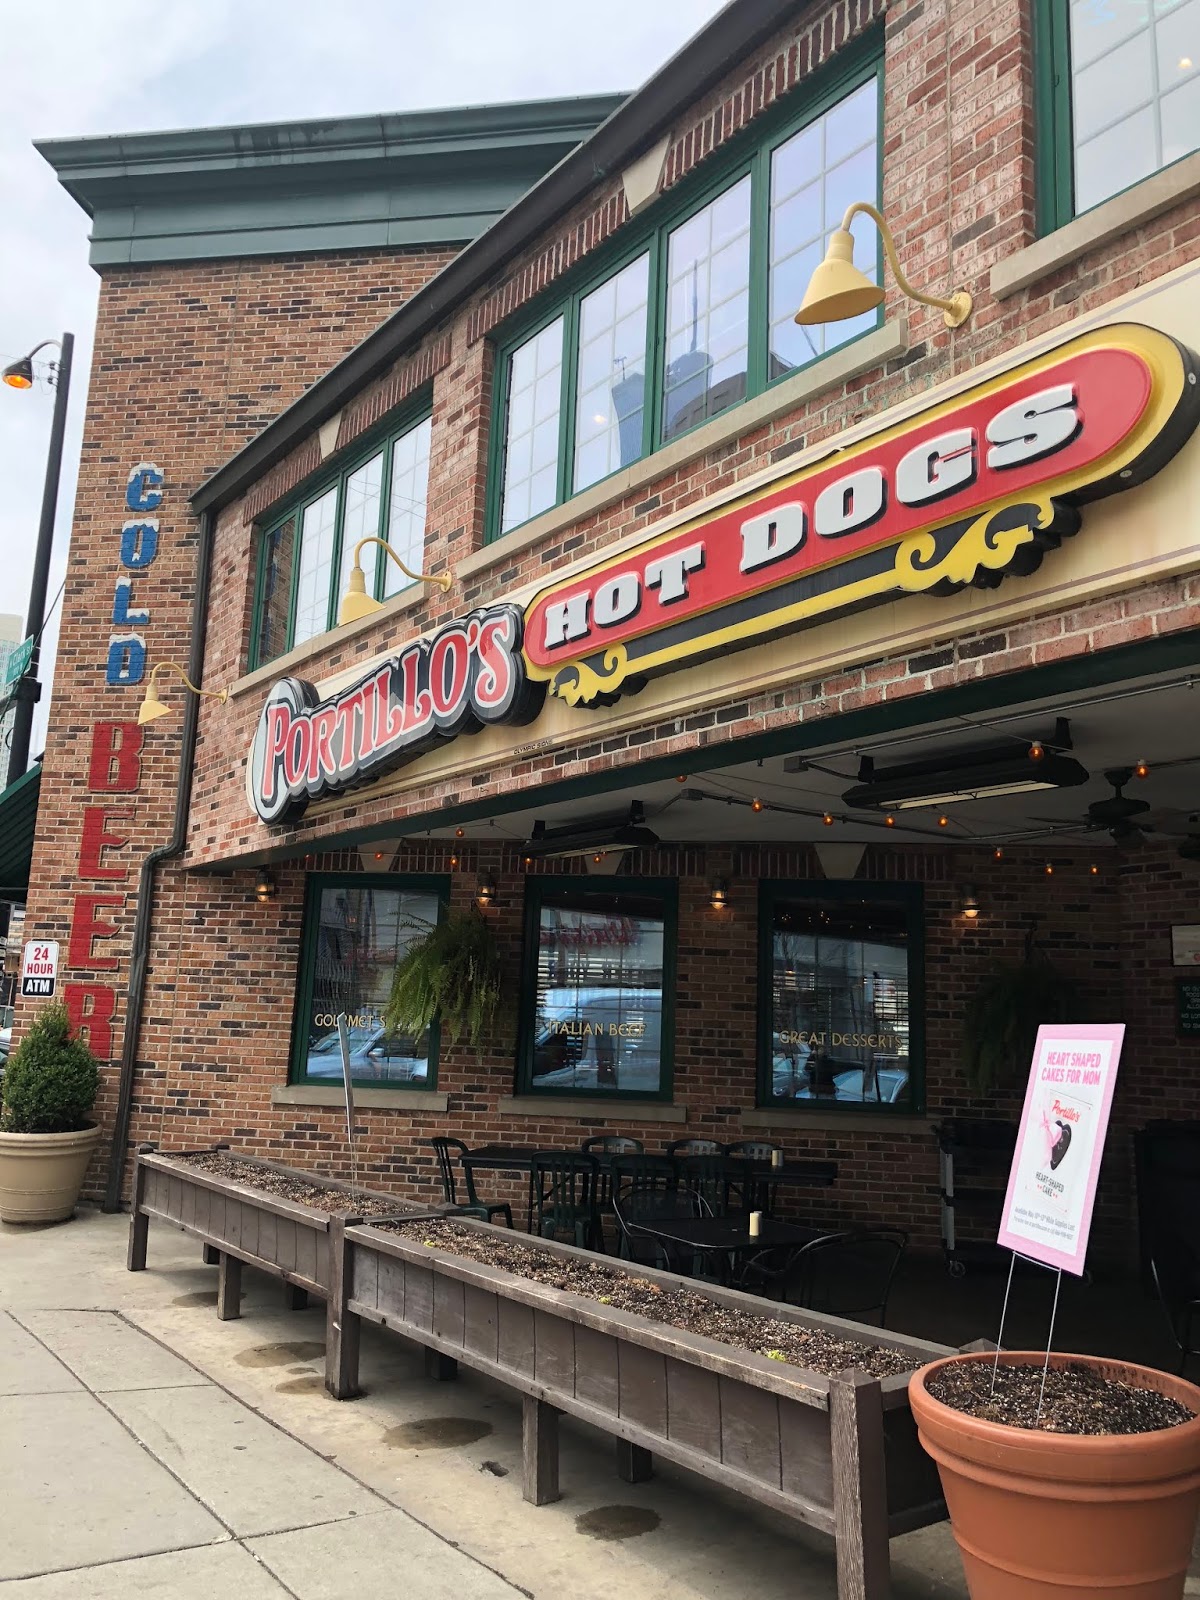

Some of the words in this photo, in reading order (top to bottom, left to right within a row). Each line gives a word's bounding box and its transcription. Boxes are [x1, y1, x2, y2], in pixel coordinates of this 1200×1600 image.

[543, 540, 706, 651] HOT
[738, 382, 1085, 576] DOGS
[106, 462, 164, 685] COLD
[261, 612, 511, 801] PORTILLO'S
[63, 720, 144, 1062] BEER
[33, 946, 50, 961] 24
[26, 962, 54, 975] HOUR
[25, 978, 51, 993] ATM
[549, 1020, 604, 1036] ITALIAN
[608, 1022, 647, 1038] BEEF
[778, 1029, 827, 1046] GREAT
[831, 1031, 903, 1049] DESSERTS
[1046, 1050, 1072, 1067] HEART
[1070, 1051, 1102, 1069] SHAPED
[1040, 1066, 1065, 1083] CAKES
[1065, 1068, 1082, 1085] FOR
[1081, 1069, 1102, 1087] MOM
[1051, 1099, 1081, 1123] Portillo's
[1042, 1184, 1054, 1198] CAKE
